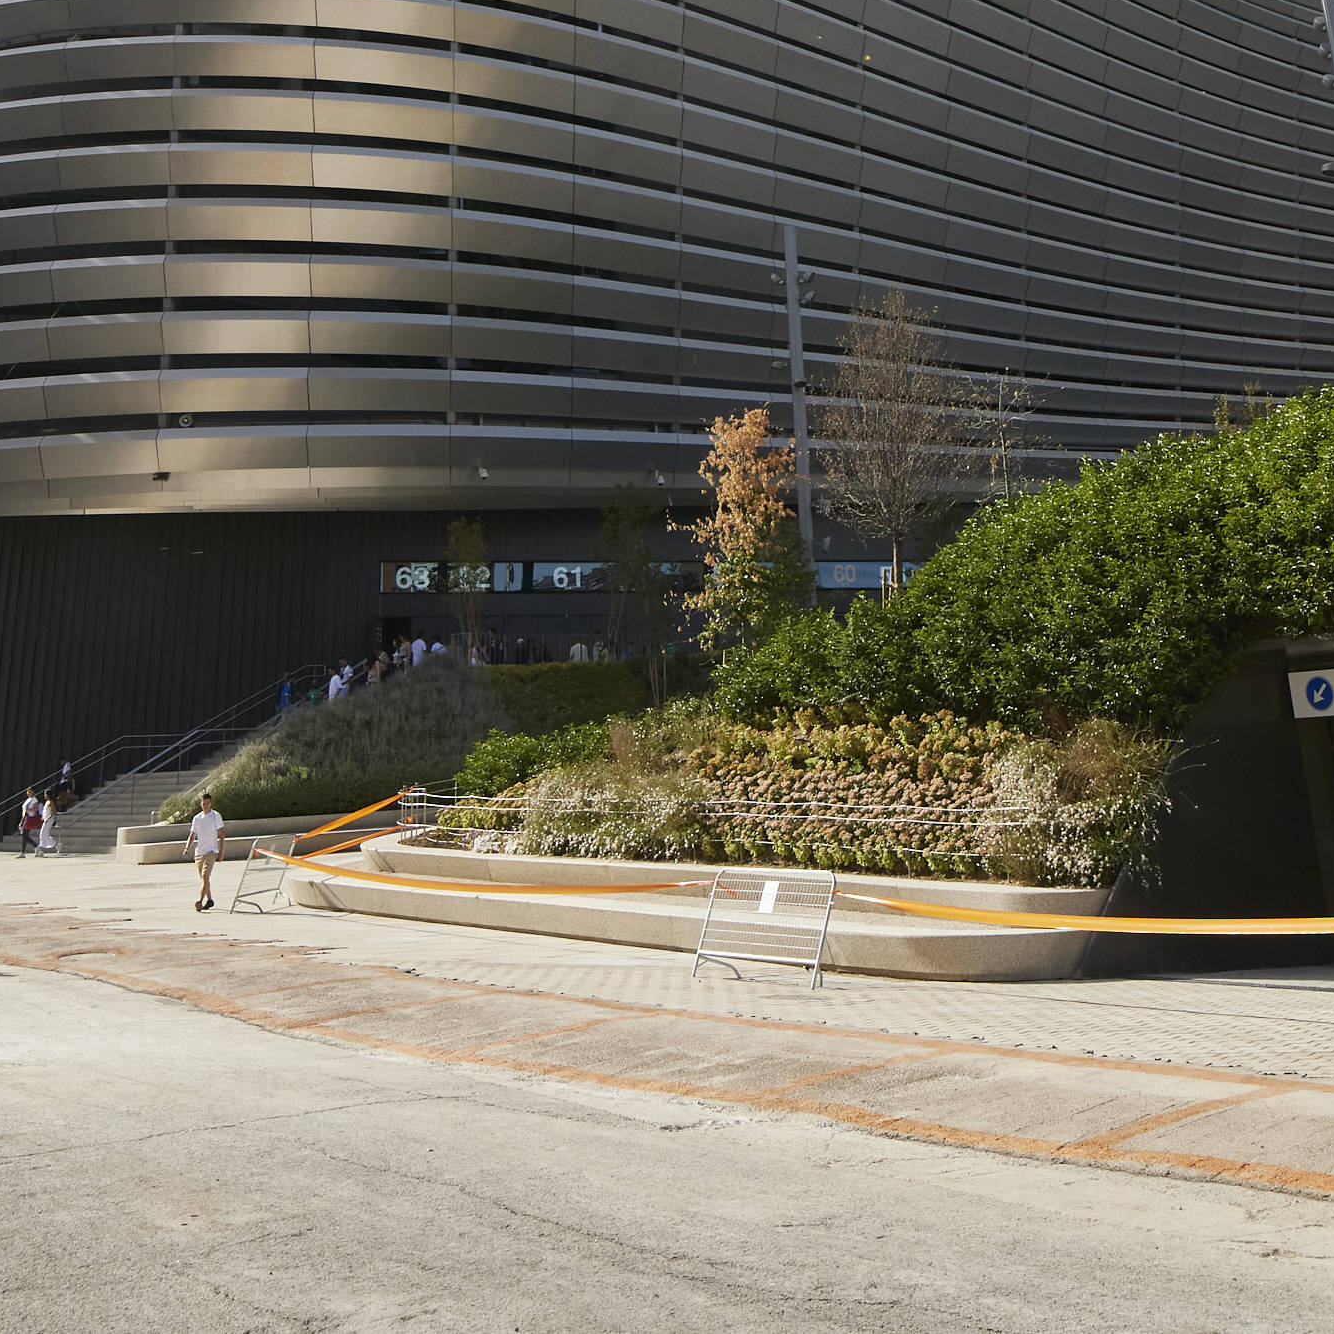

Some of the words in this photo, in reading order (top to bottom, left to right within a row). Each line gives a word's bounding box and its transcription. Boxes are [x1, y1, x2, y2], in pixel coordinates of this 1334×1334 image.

[396, 566, 430, 589] 63
[553, 567, 582, 588] 61
[834, 564, 856, 583] 60
